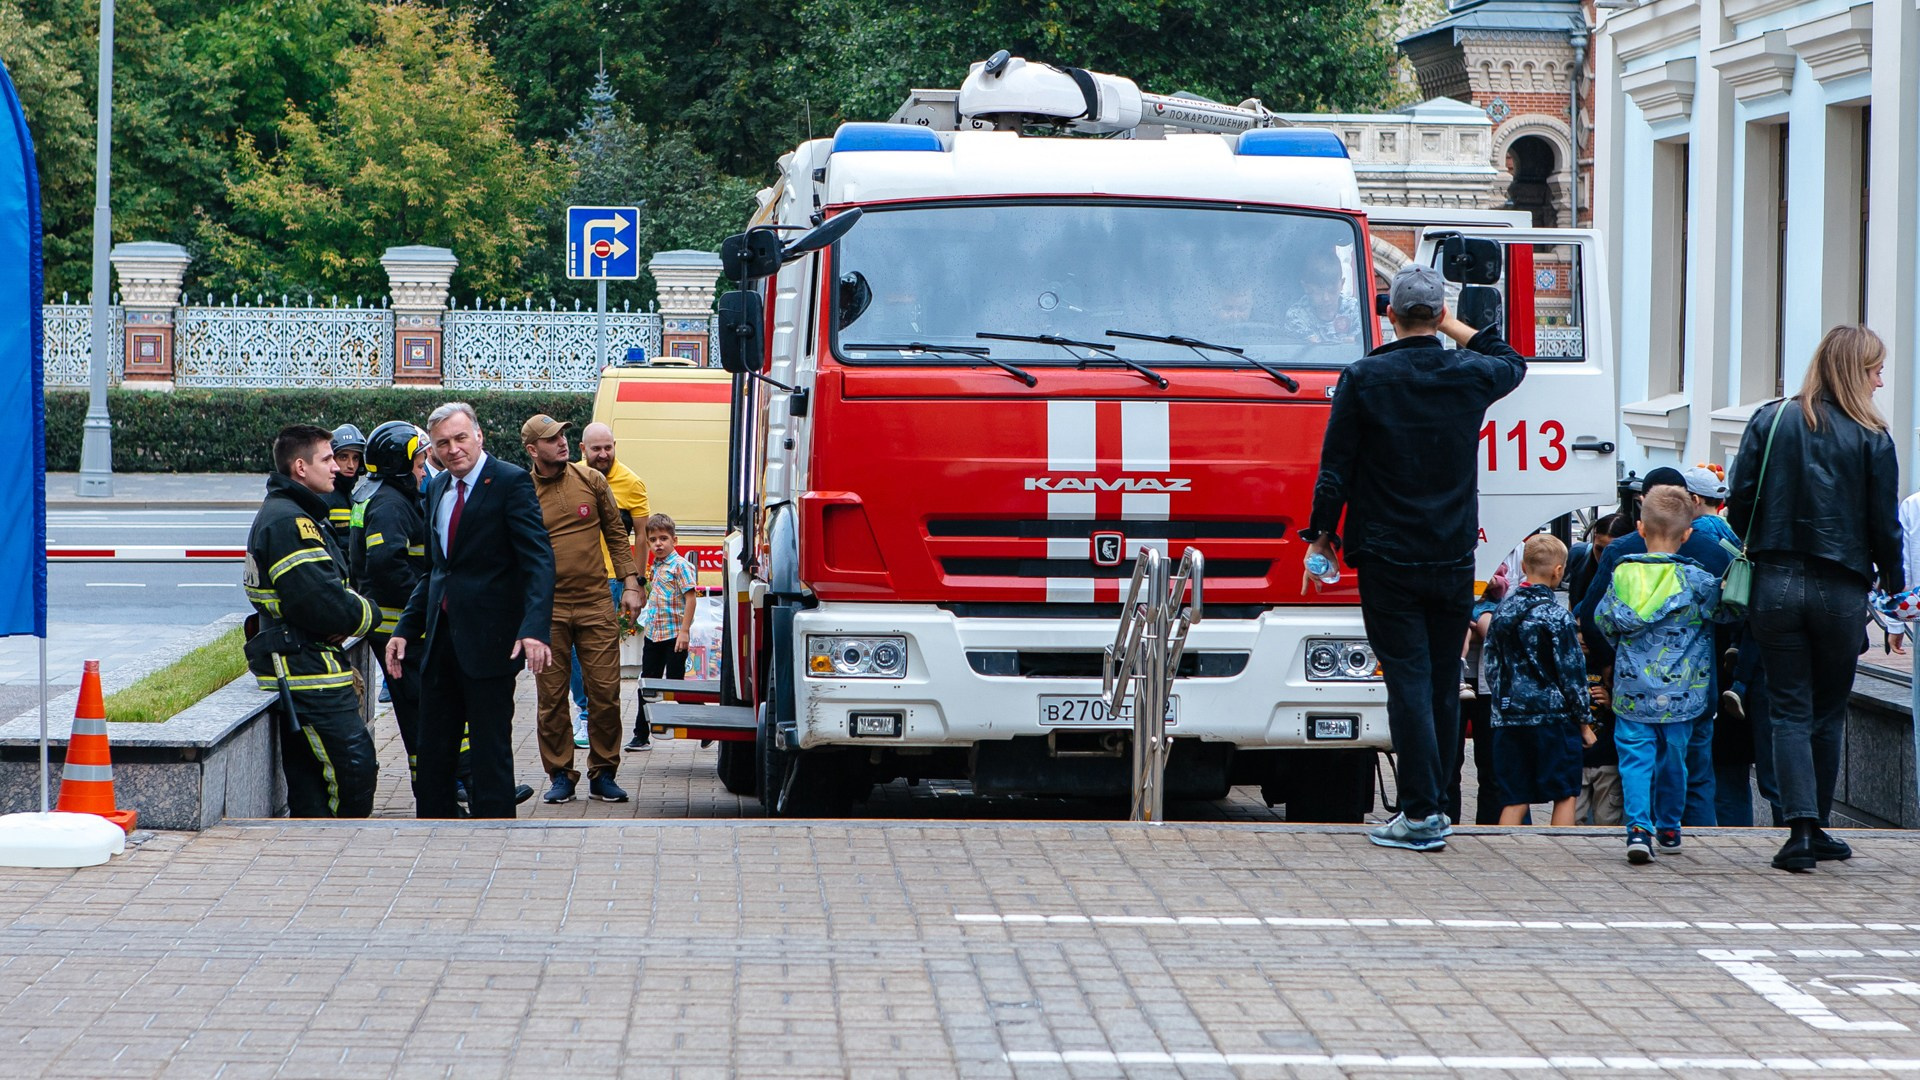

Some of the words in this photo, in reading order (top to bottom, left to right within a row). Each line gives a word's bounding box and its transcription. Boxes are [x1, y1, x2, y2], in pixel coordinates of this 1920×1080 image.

[1169, 109, 1249, 130] ПОЖАРОТУШЕНИЯ
[1479, 420, 1567, 471] 113
[1024, 477, 1191, 491] KAMAZ
